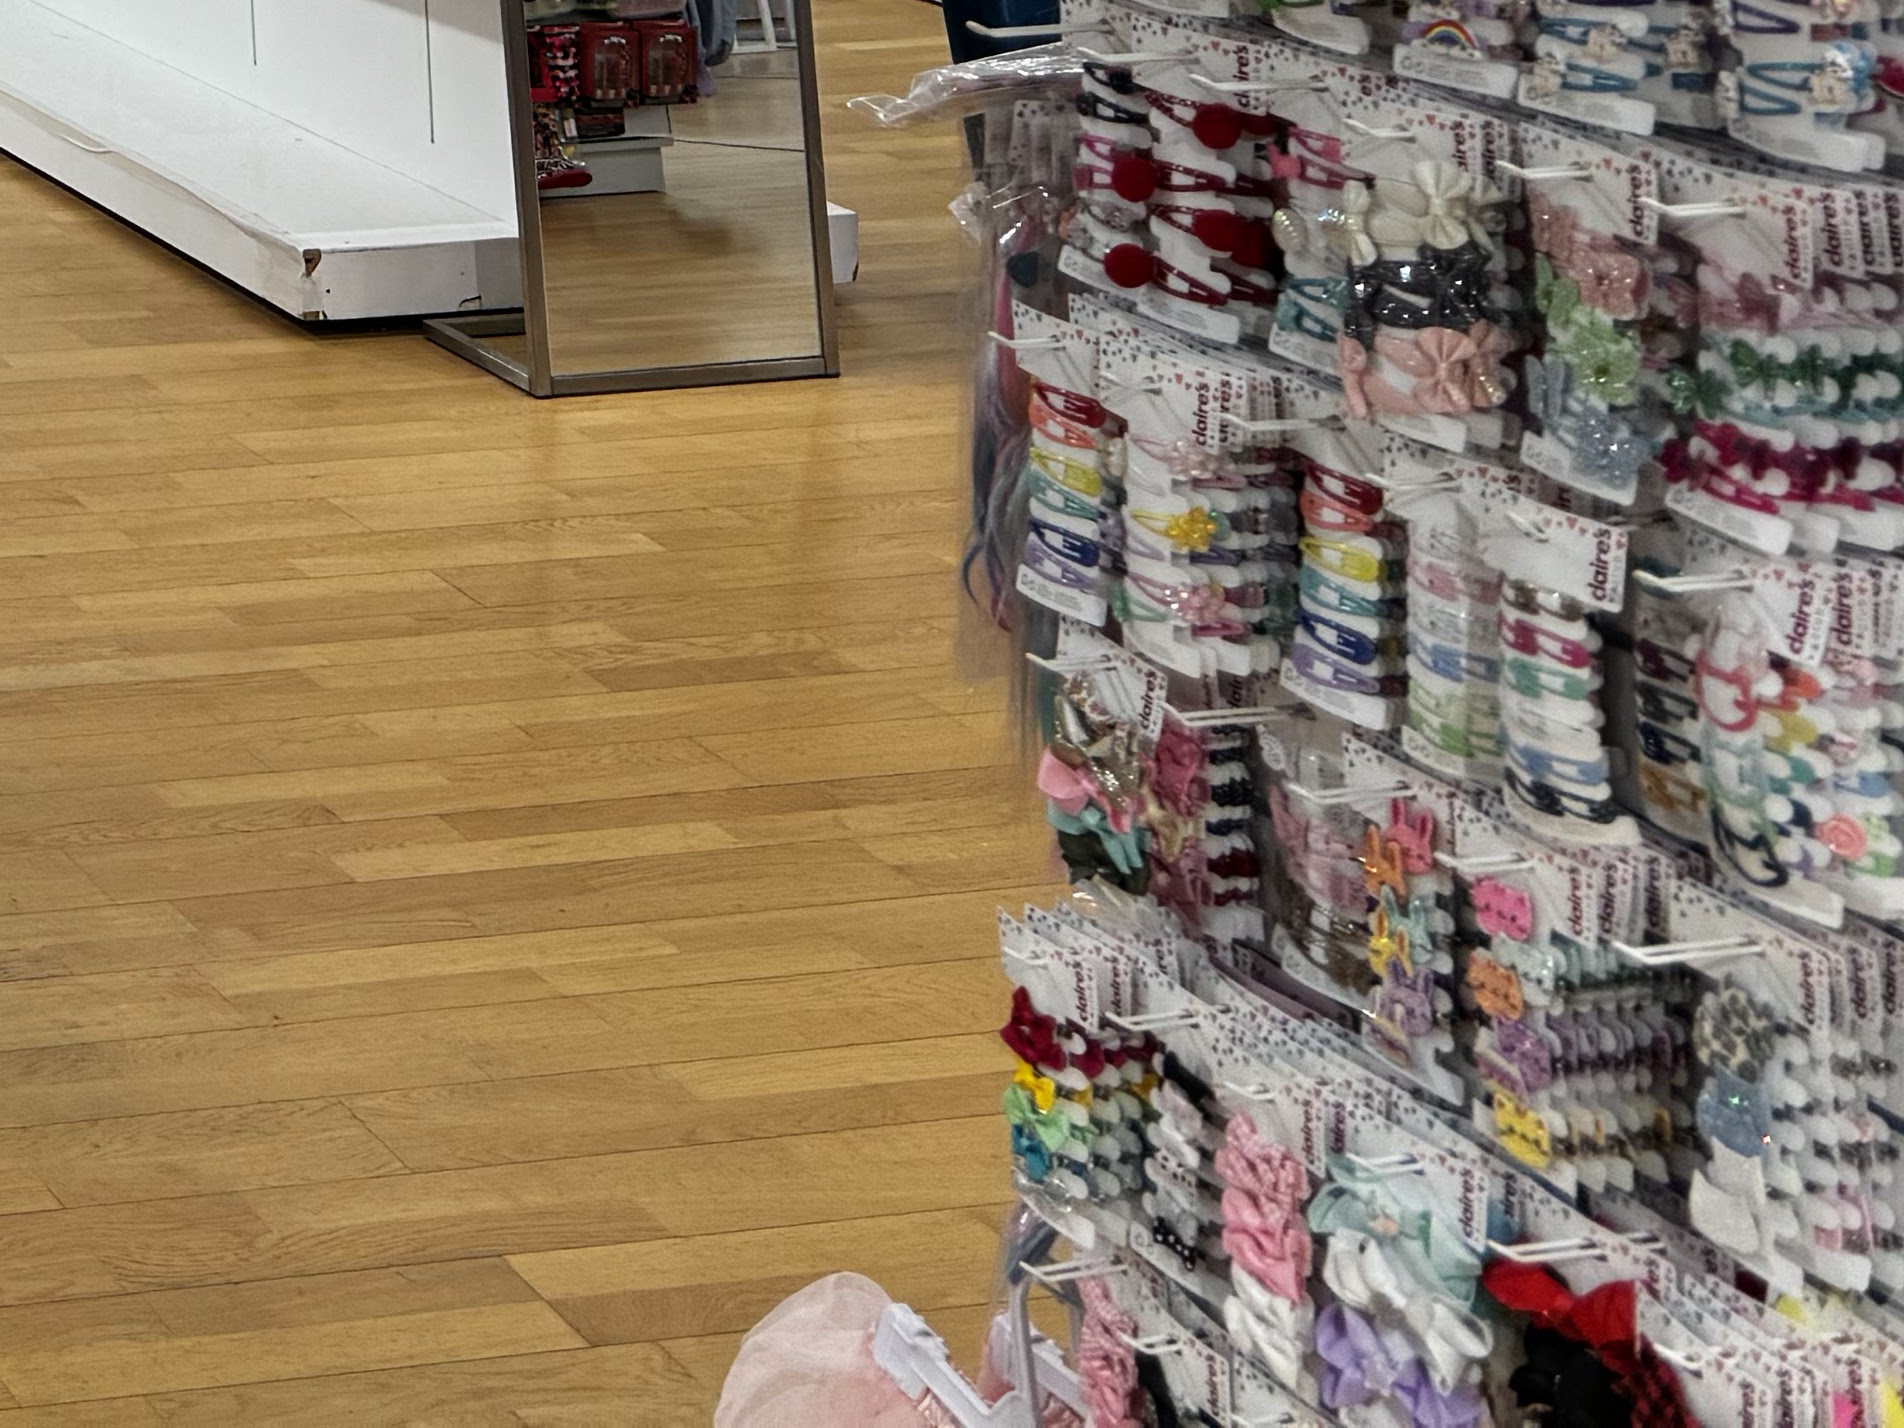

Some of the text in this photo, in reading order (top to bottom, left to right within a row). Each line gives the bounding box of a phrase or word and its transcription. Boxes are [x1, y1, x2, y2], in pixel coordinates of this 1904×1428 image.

[1783, 206, 1801, 278] claire's
[1819, 192, 1840, 265] claire's
[1190, 383, 1210, 446] claire's
[1587, 529, 1610, 601] claire's
[1784, 580, 1813, 653] claire's
[1830, 572, 1851, 645] claire's
[1139, 672, 1156, 729] claire's
[1457, 1168, 1476, 1238] claire's
